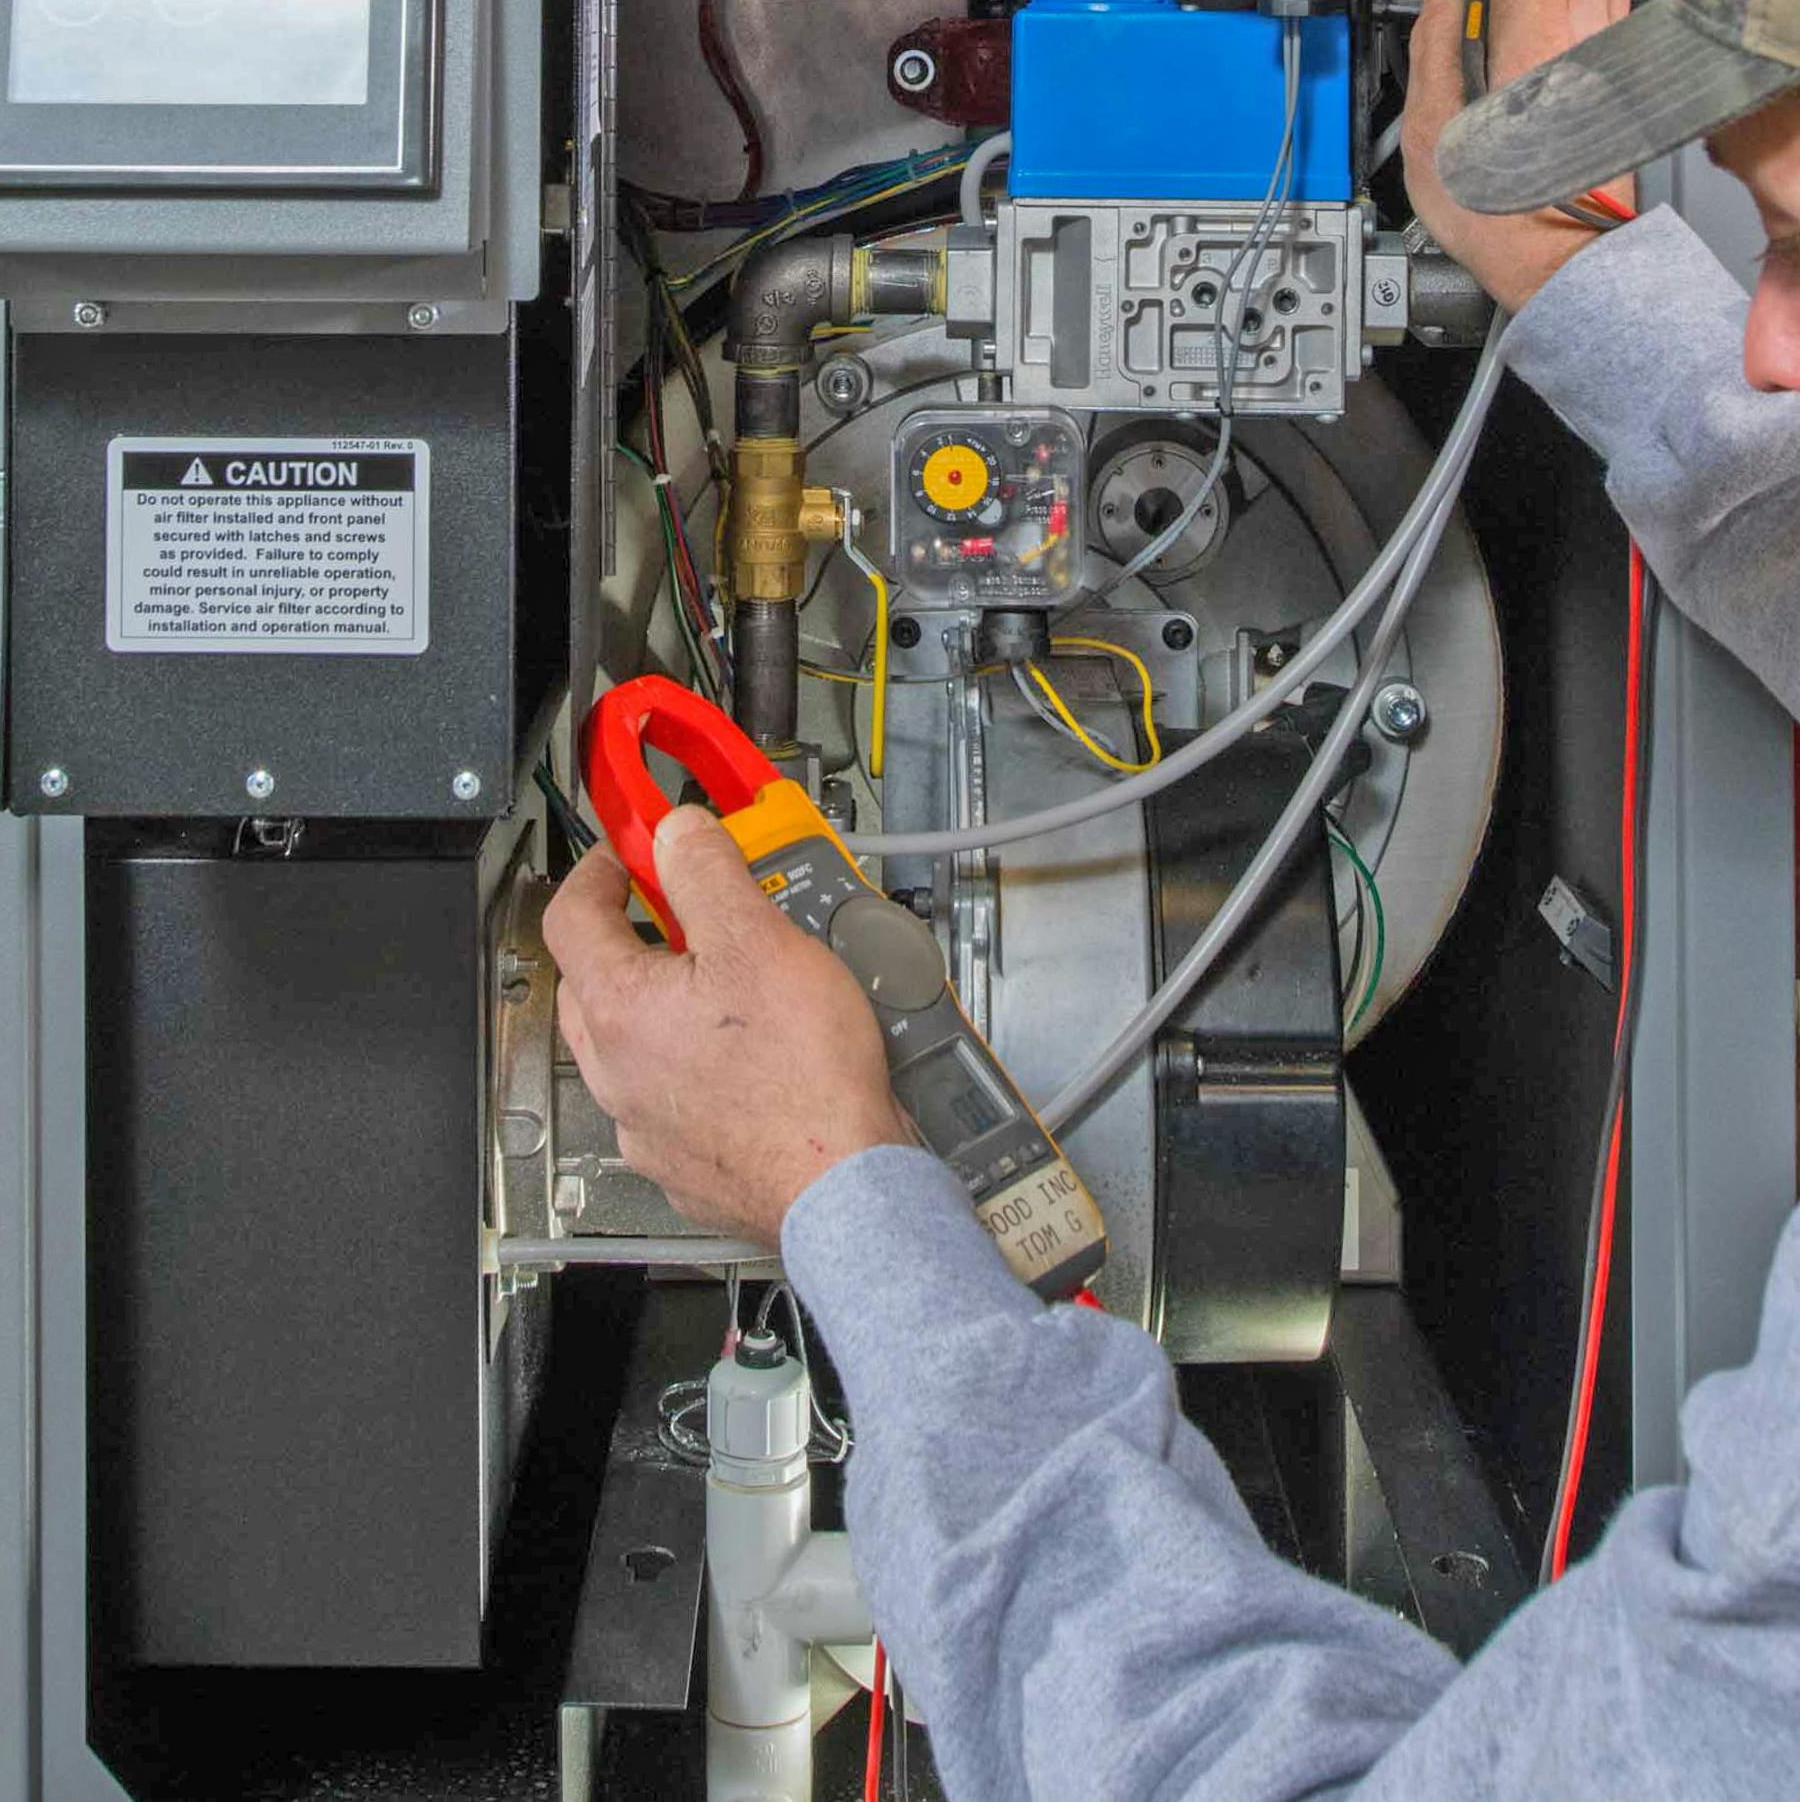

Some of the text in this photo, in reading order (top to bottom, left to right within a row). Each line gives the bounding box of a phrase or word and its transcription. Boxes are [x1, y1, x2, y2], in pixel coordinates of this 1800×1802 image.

[1095, 283, 1113, 380] Honeywell
[332, 440, 380, 450] 112547-01
[383, 440, 403, 450] Rev.
[225, 461, 358, 486] CAUTION
[136, 492, 403, 509] Do not operate this appliance without
[153, 511, 386, 528] air filter installed and front panel
[153, 529, 386, 544] secured with latches and screws
[159, 547, 380, 564] as provided. Failure to comply
[142, 565, 396, 582] could result in unreliable operation,
[149, 583, 389, 600] minor personal injury, or property
[133, 601, 405, 618] damage. Service air filter according to
[148, 619, 390, 636] installation and operation manual.
[1036, 1169, 1078, 1206] INC
[1015, 1209, 1084, 1263] TOM G
